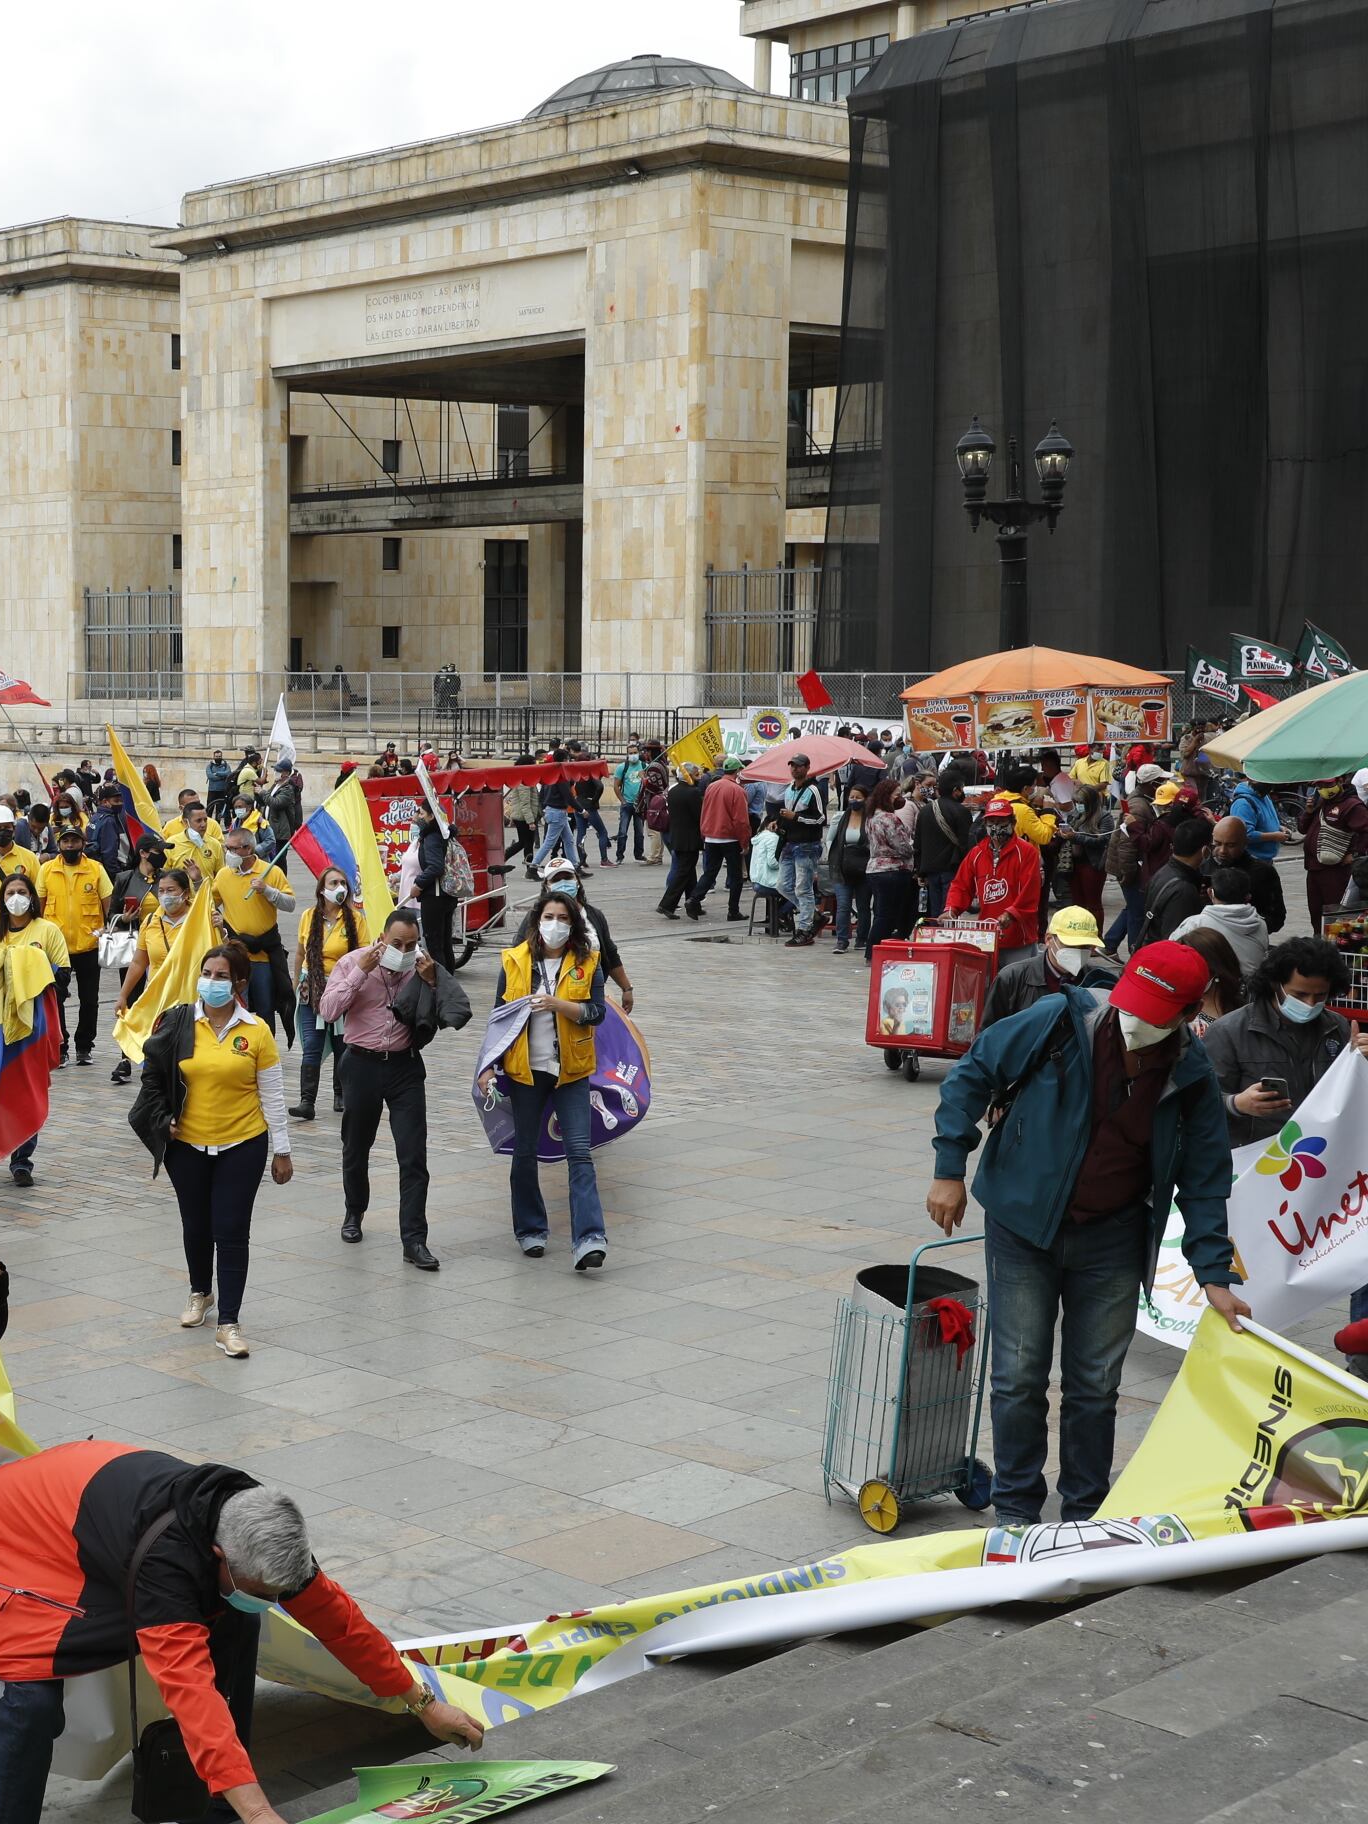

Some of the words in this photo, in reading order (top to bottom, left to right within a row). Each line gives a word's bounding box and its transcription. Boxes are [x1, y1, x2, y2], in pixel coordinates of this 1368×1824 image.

[366, 291, 423, 307] COLOMBIANOS
[434, 287, 449, 297] LAS
[453, 282, 480, 295] ARMAS
[379, 312, 393, 322] HAN
[395, 309, 418, 320] DADO
[421, 301, 480, 316] INDEPENDENCIA
[366, 332, 380, 342] LAS
[382, 329, 403, 340] LEYES
[444, 318, 480, 331] LIBERTAD
[986, 695, 1012, 704] SUPER
[1014, 690, 1076, 701] HAMBURGUESA
[1045, 697, 1085, 706] ESPECIAL
[757, 721, 781, 733] CTC
[800, 719, 831, 736] PARE
[381, 806, 417, 824] Helad
[1298, 1229, 1356, 1271] Sindicalismo
